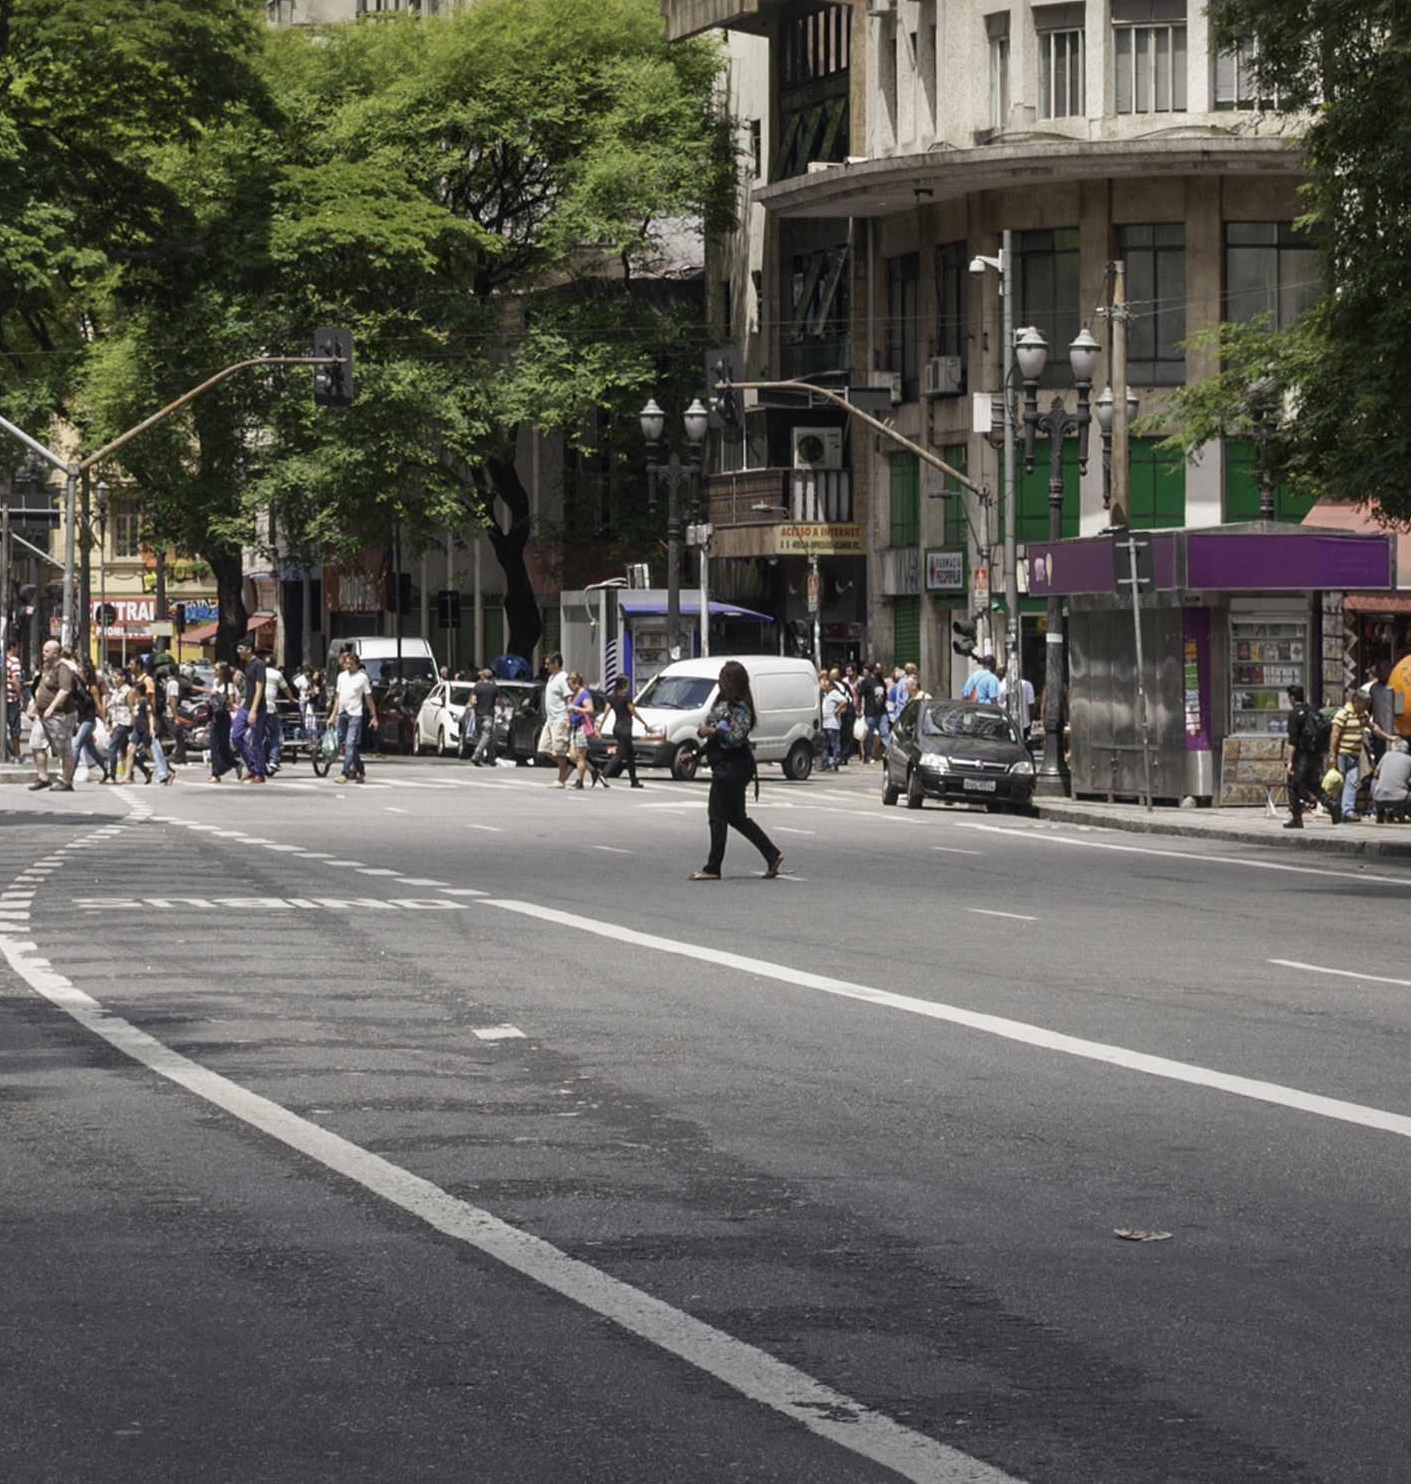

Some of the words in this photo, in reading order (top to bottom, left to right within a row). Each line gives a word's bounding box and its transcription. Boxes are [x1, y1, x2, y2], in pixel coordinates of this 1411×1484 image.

[781, 527, 811, 537] ACESSO
[813, 528, 819, 537] A
[821, 527, 860, 537] INTERNET
